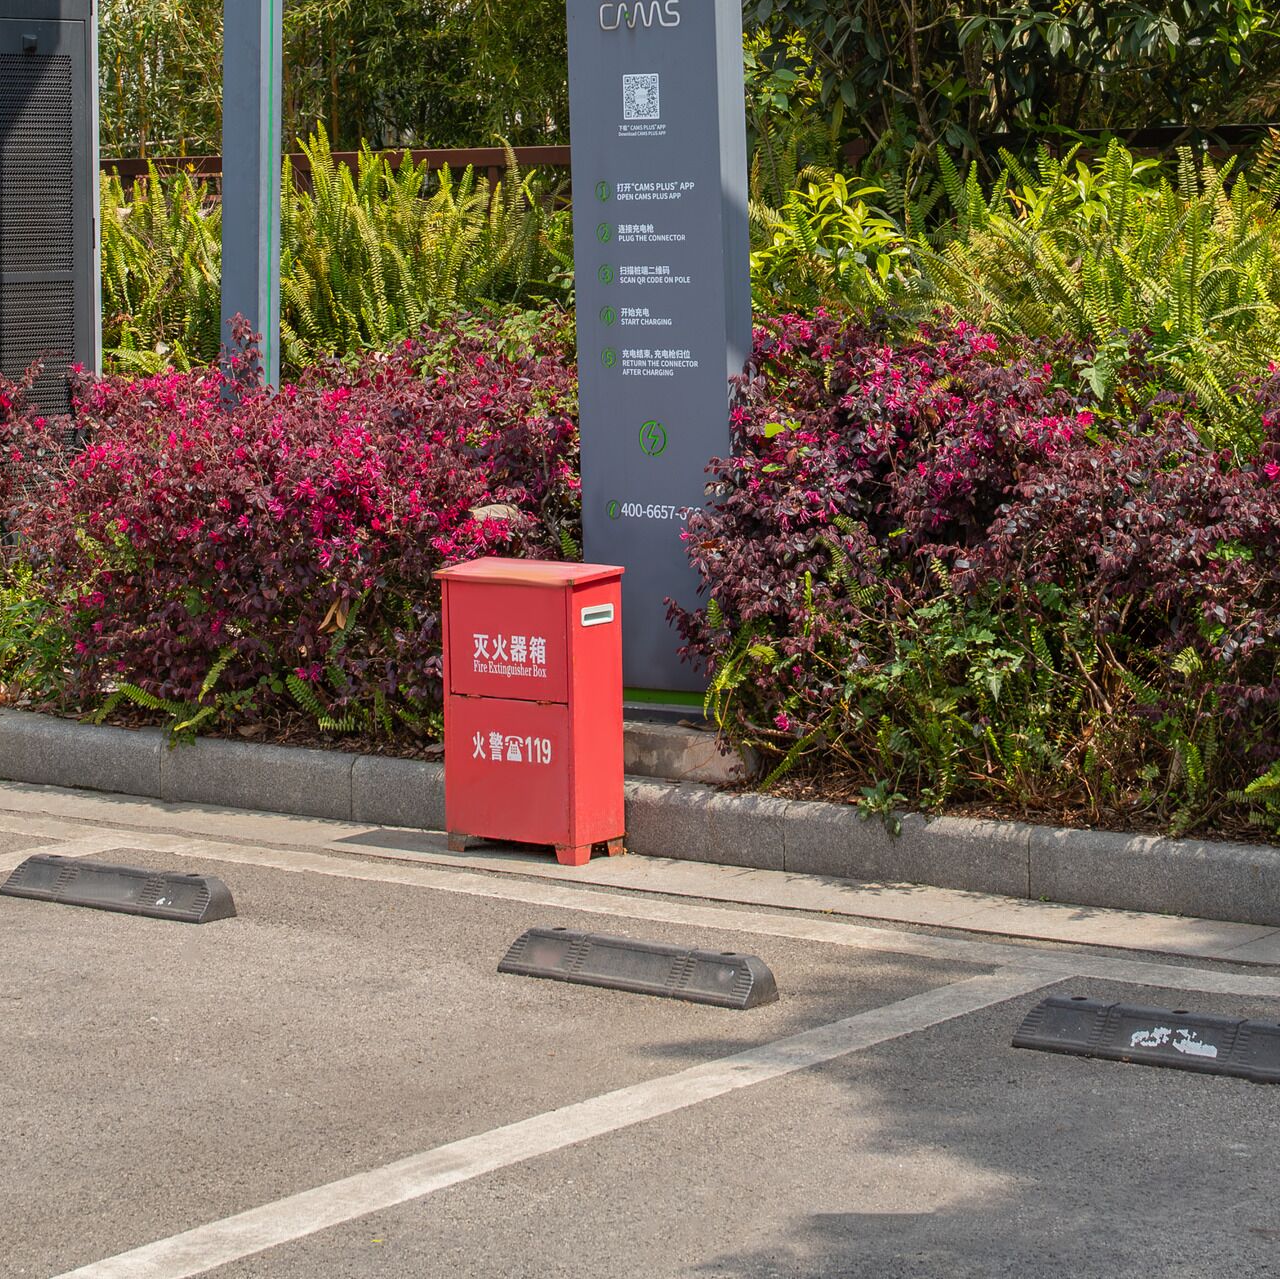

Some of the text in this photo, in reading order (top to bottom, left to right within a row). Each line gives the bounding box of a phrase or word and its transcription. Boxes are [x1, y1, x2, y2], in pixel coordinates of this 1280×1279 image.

[600, 0, 681, 30] CAMS
[680, 181, 695, 190] APP
[617, 193, 634, 201] OPEN
[618, 224, 655, 234] 连接充电枪
[618, 234, 634, 242] PLUG
[648, 234, 686, 242] CONNECTOR
[620, 266, 670, 275] 扫描桩端二维码
[620, 276, 636, 284] SCAN
[637, 276, 646, 285] QR
[647, 276, 663, 284] CODE
[621, 307, 650, 317] 开始充电
[621, 318, 672, 326] START CHARGING
[660, 360, 699, 368] CONNECTOR
[642, 369, 674, 377] CHARGING
[473, 633, 546, 665] 灭火器箱
[473, 659, 547, 678] Fire Extinguisher Box
[472, 731, 552, 764] 火警 119
